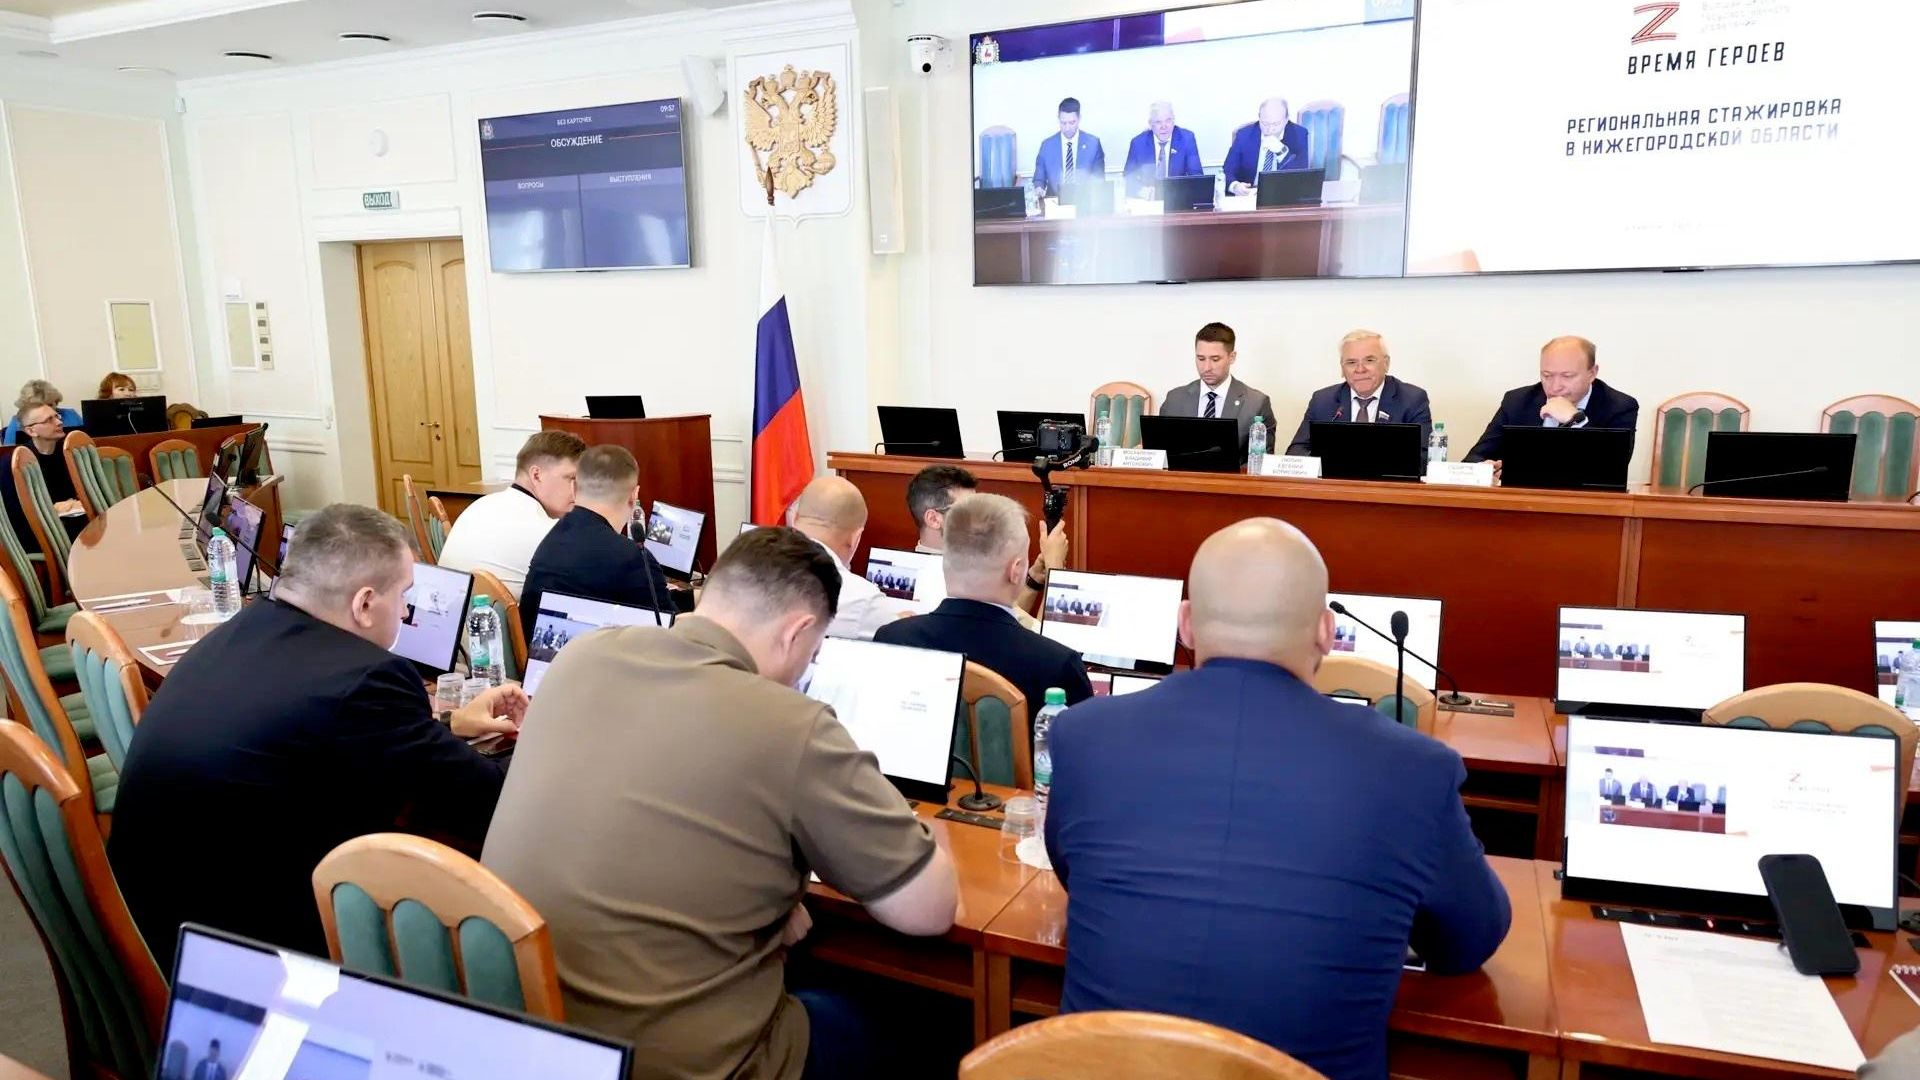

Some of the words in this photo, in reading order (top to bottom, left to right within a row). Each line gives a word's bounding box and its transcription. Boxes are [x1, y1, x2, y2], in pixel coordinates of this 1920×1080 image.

[1627, 50, 1696, 75] ВРЕМЯ
[1707, 42, 1786, 68] ГЕРОЕВ
[566, 116, 593, 125] КАРТОЧЕК
[1567, 109, 1701, 134] РЕГИОНАЛЬНАЯ
[1708, 98, 1843, 124] СТАЖИРОВКА
[550, 134, 604, 148] ОБСУЖДЕНИЕ
[1565, 141, 1576, 156] В
[1582, 127, 1743, 155] НИЖЕГОРОДСКОЙ
[1750, 123, 1840, 145] ОБЛАСТИ
[517, 180, 544, 190] ВОПРОСЫ
[609, 173, 653, 184] ВЫСТУПЛЕНИЯ
[364, 192, 391, 207] ВЫХОД
